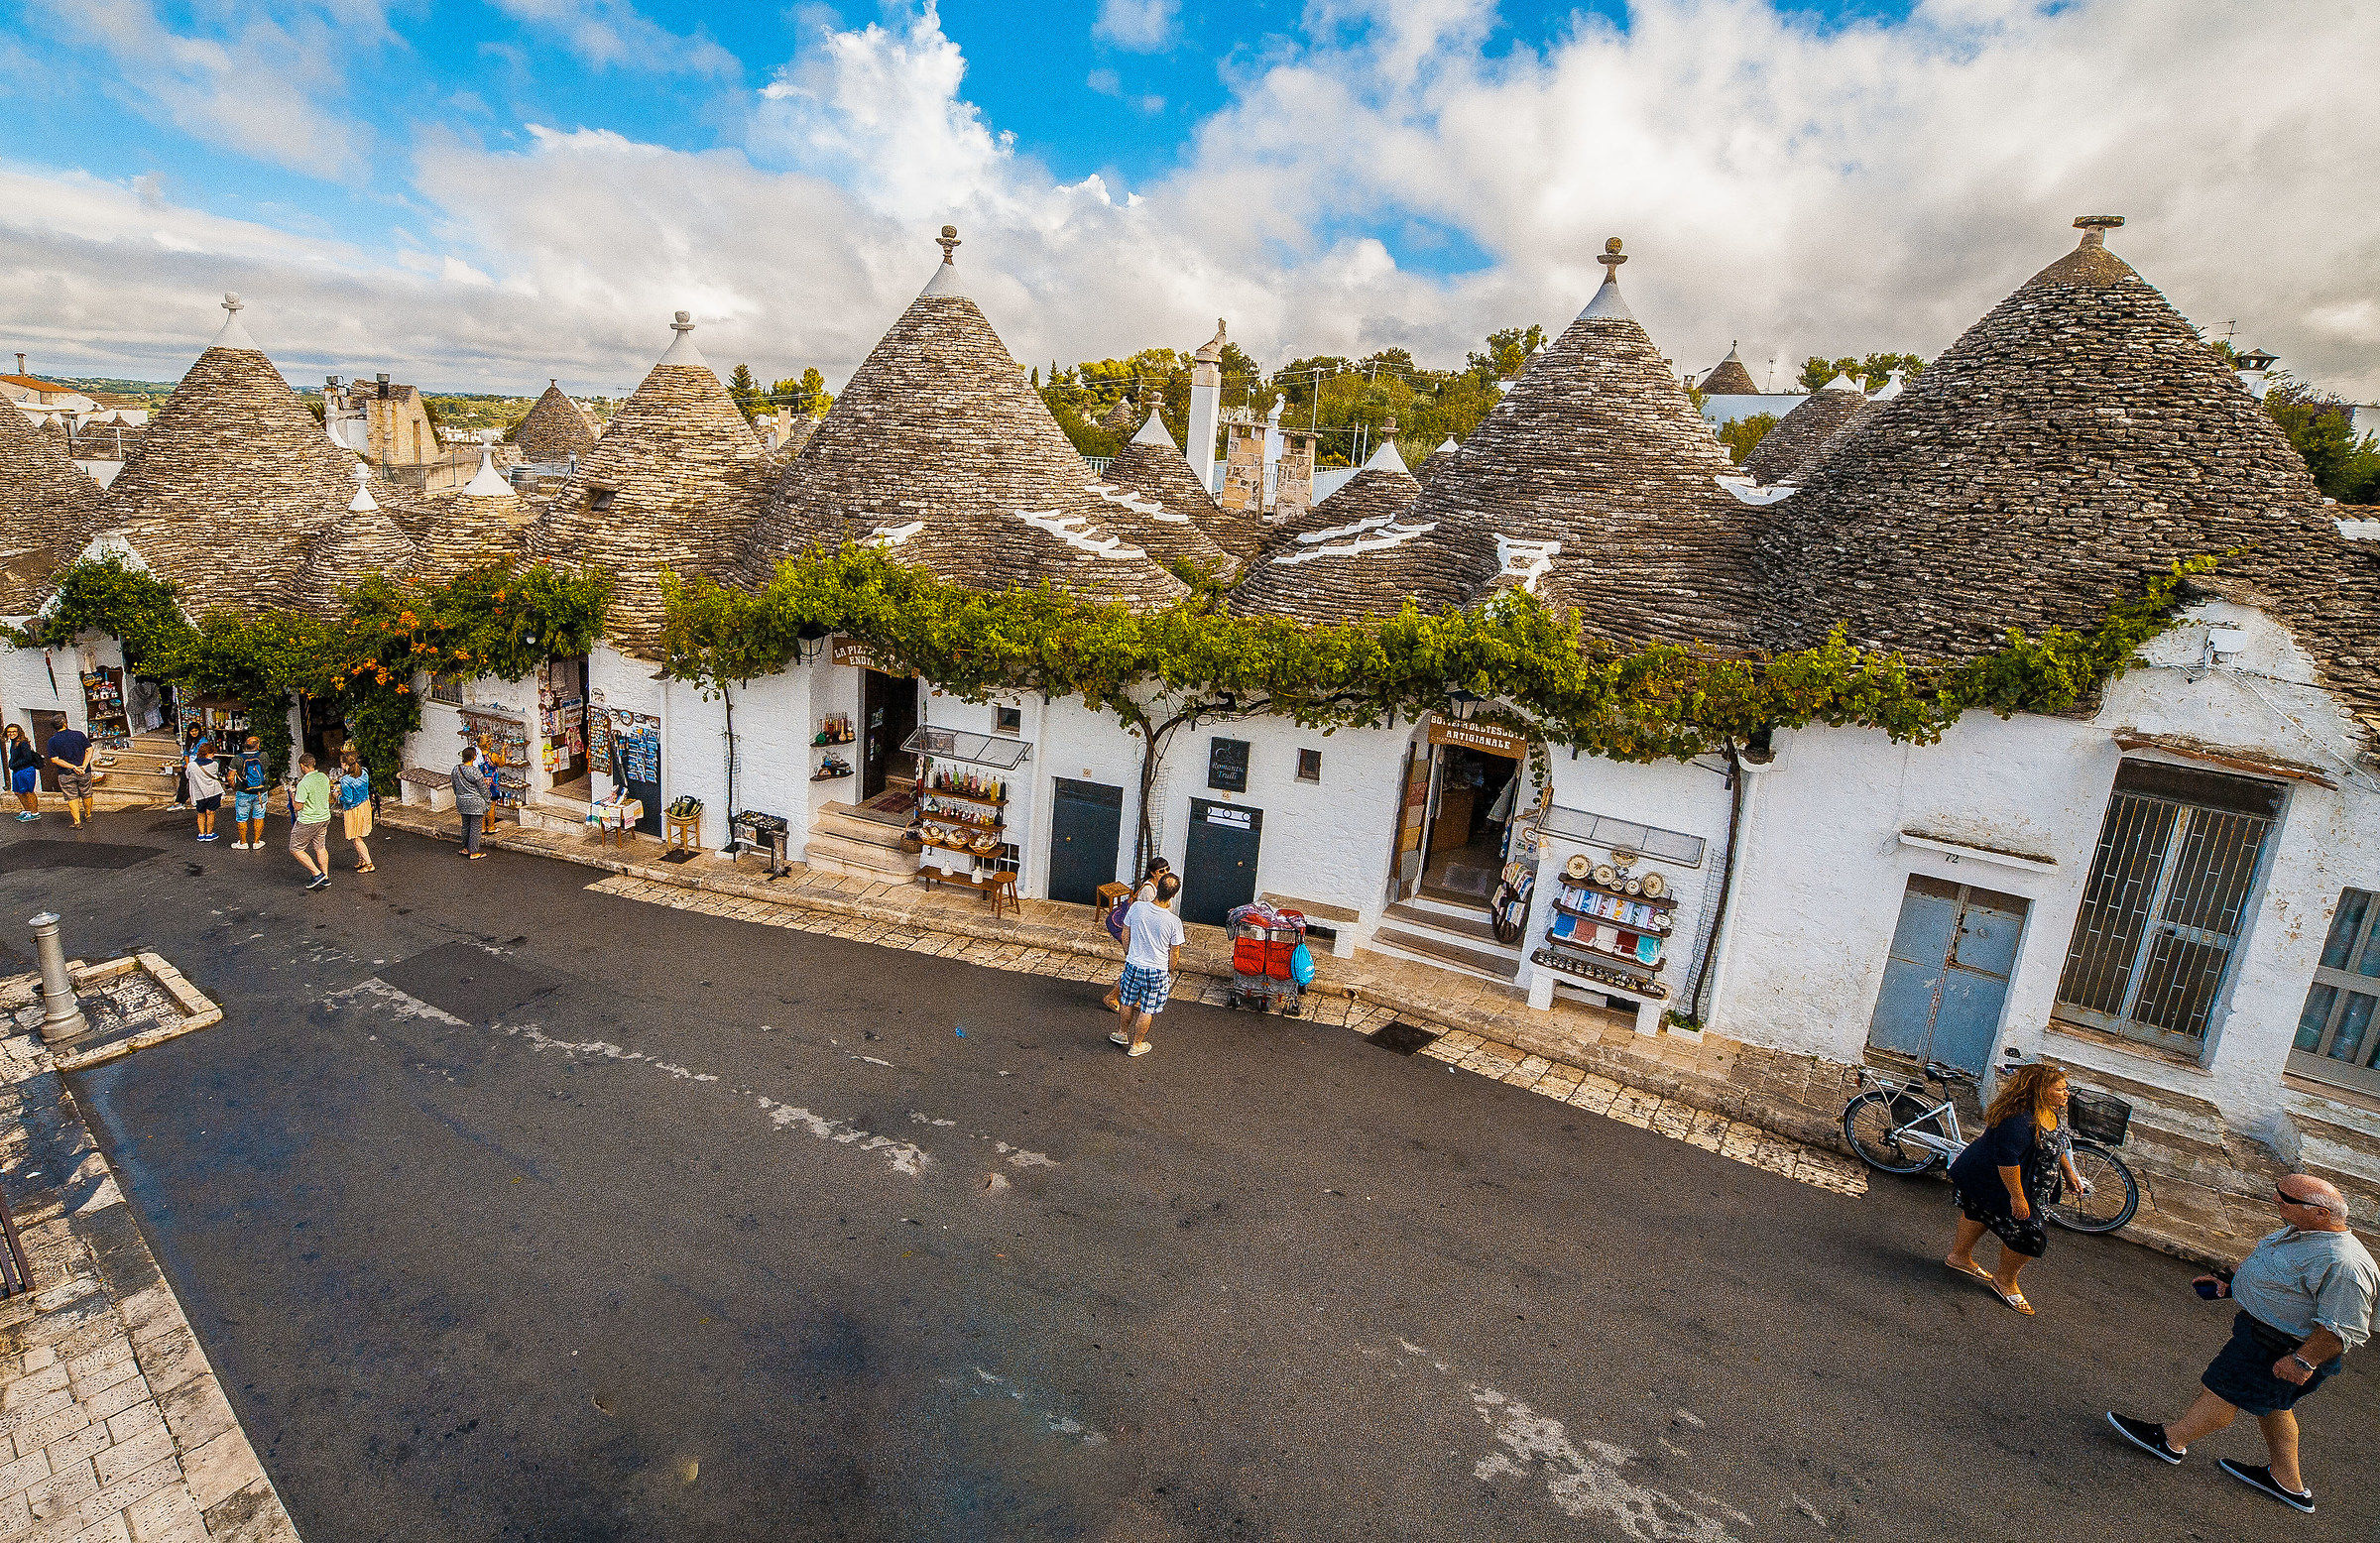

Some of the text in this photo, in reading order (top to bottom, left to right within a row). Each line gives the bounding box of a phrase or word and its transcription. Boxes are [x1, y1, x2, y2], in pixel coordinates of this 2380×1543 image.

[834, 647, 847, 658] LA
[1446, 730, 1511, 750] ARTIGIANALE
[1218, 771, 1238, 780] Trulli
[1946, 853, 1960, 864] 72
